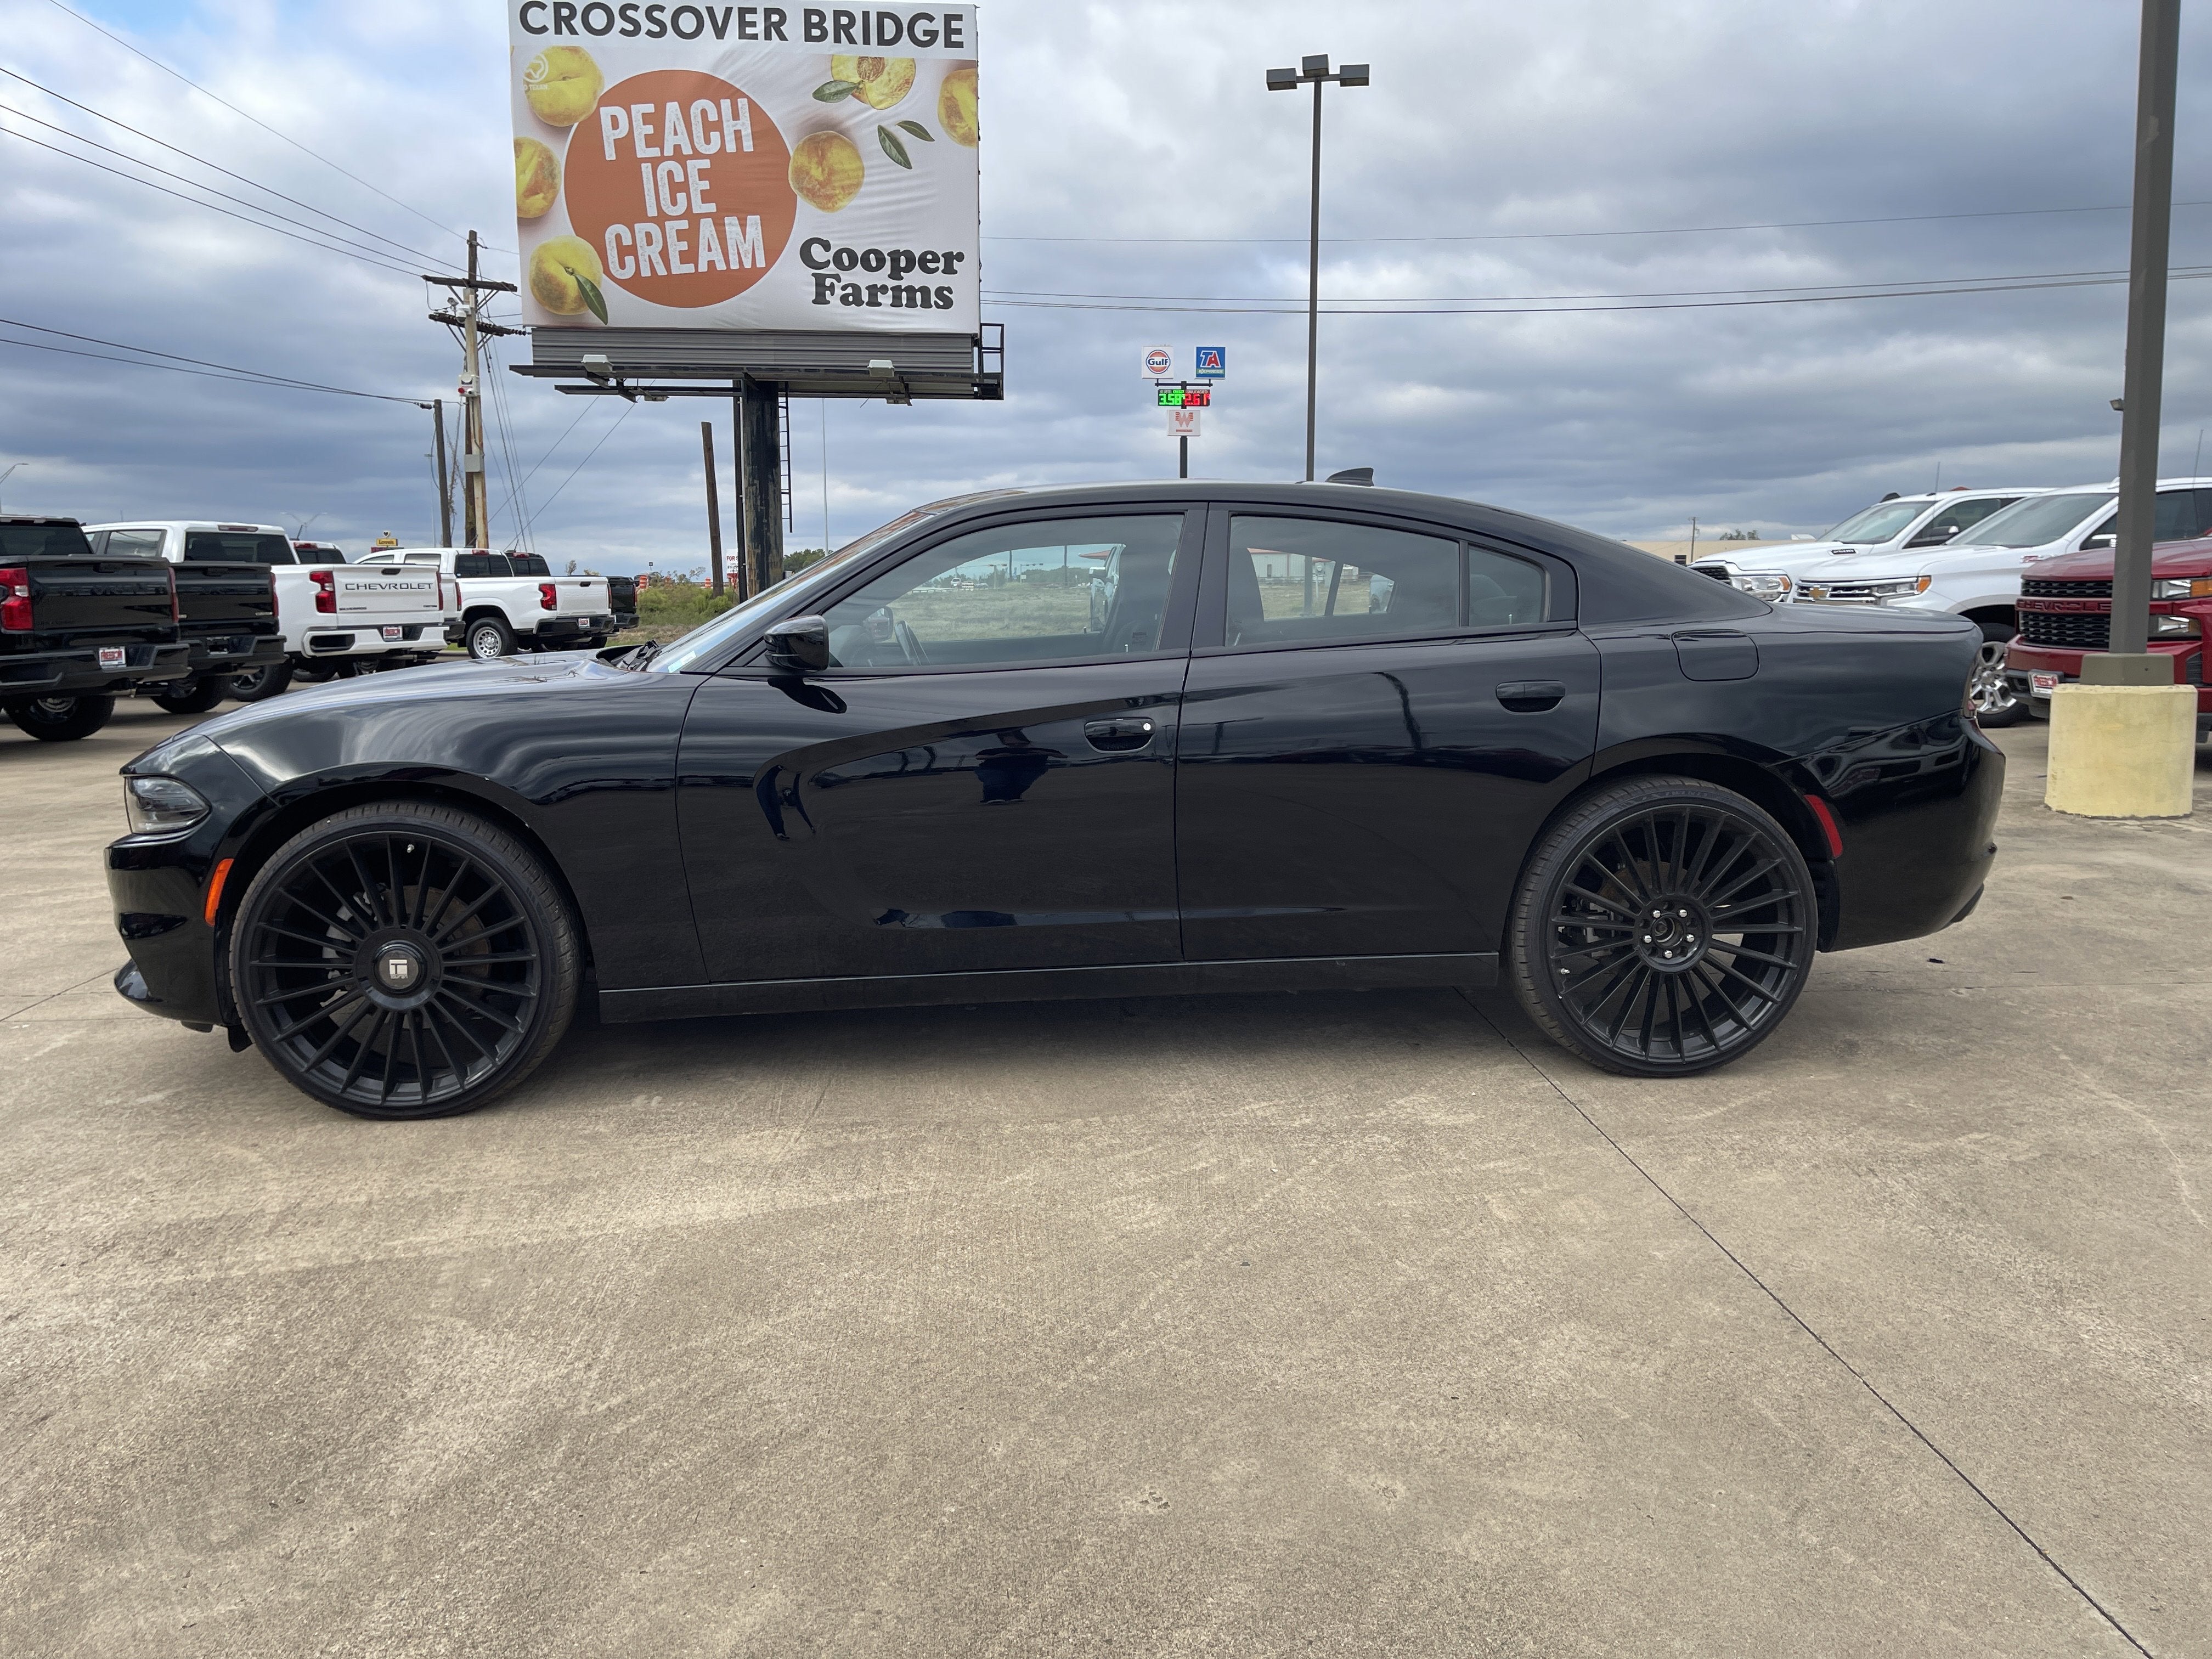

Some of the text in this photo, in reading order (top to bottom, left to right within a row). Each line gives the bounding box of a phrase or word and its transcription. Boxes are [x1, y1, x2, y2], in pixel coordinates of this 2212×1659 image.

[518, 0, 965, 49] CROSSOVER BRIDGE
[600, 98, 754, 160] PEACH
[641, 159, 716, 217] ICE
[605, 215, 766, 279] CREAM
[799, 237, 965, 280] Cooper
[811, 273, 953, 309] Farms
[1200, 350, 1221, 368] TA
[2017, 600, 2113, 613] CHEVROLE
